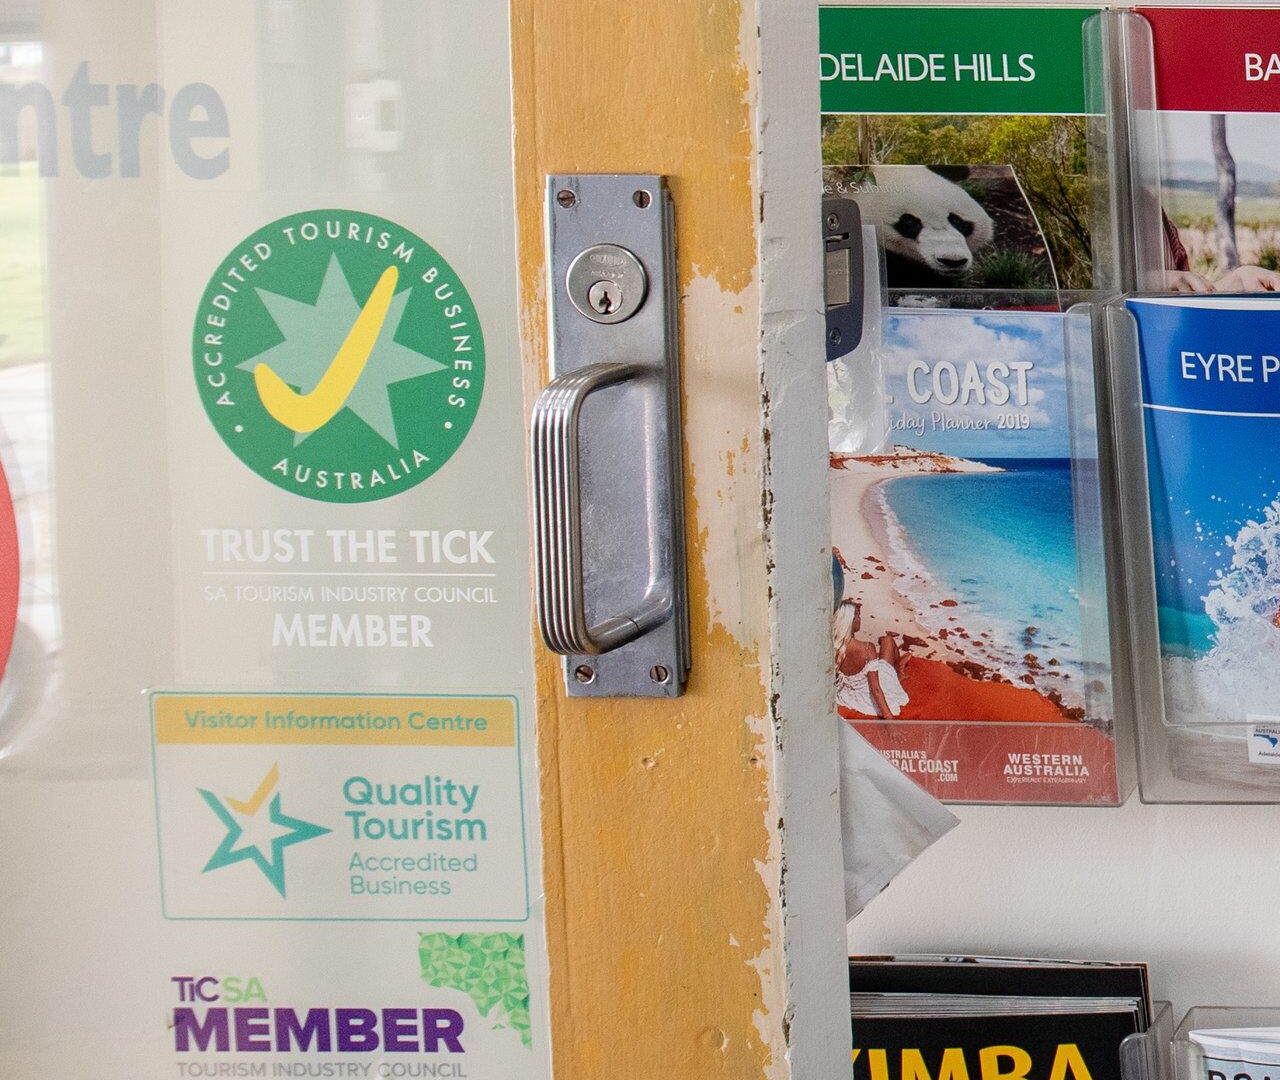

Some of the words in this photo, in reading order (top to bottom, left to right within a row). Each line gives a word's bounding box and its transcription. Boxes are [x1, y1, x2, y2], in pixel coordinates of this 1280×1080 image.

[205, 242, 271, 408] ACCREDITED
[284, 221, 414, 264] TOURISM
[422, 267, 472, 409] BUSINESS
[1181, 352, 1252, 382] EYRE
[273, 448, 430, 489] AUSTRALIA
[200, 529, 314, 563] TRUST
[326, 530, 397, 563] THE
[410, 530, 495, 564] TICK
[204, 586, 227, 602] SA
[234, 586, 313, 603] TOURISM
[322, 587, 406, 603] INDUSTRY
[414, 587, 497, 603] COUNCIL
[272, 614, 433, 648] MEMBER
[183, 711, 257, 729] Visitor
[265, 711, 400, 730] Information
[408, 712, 487, 731] Centre
[343, 776, 479, 813] Quality
[345, 811, 487, 841] Tourism
[349, 853, 478, 872] Accredited
[350, 877, 451, 895] Business
[174, 1008, 465, 1052] MEMBER
